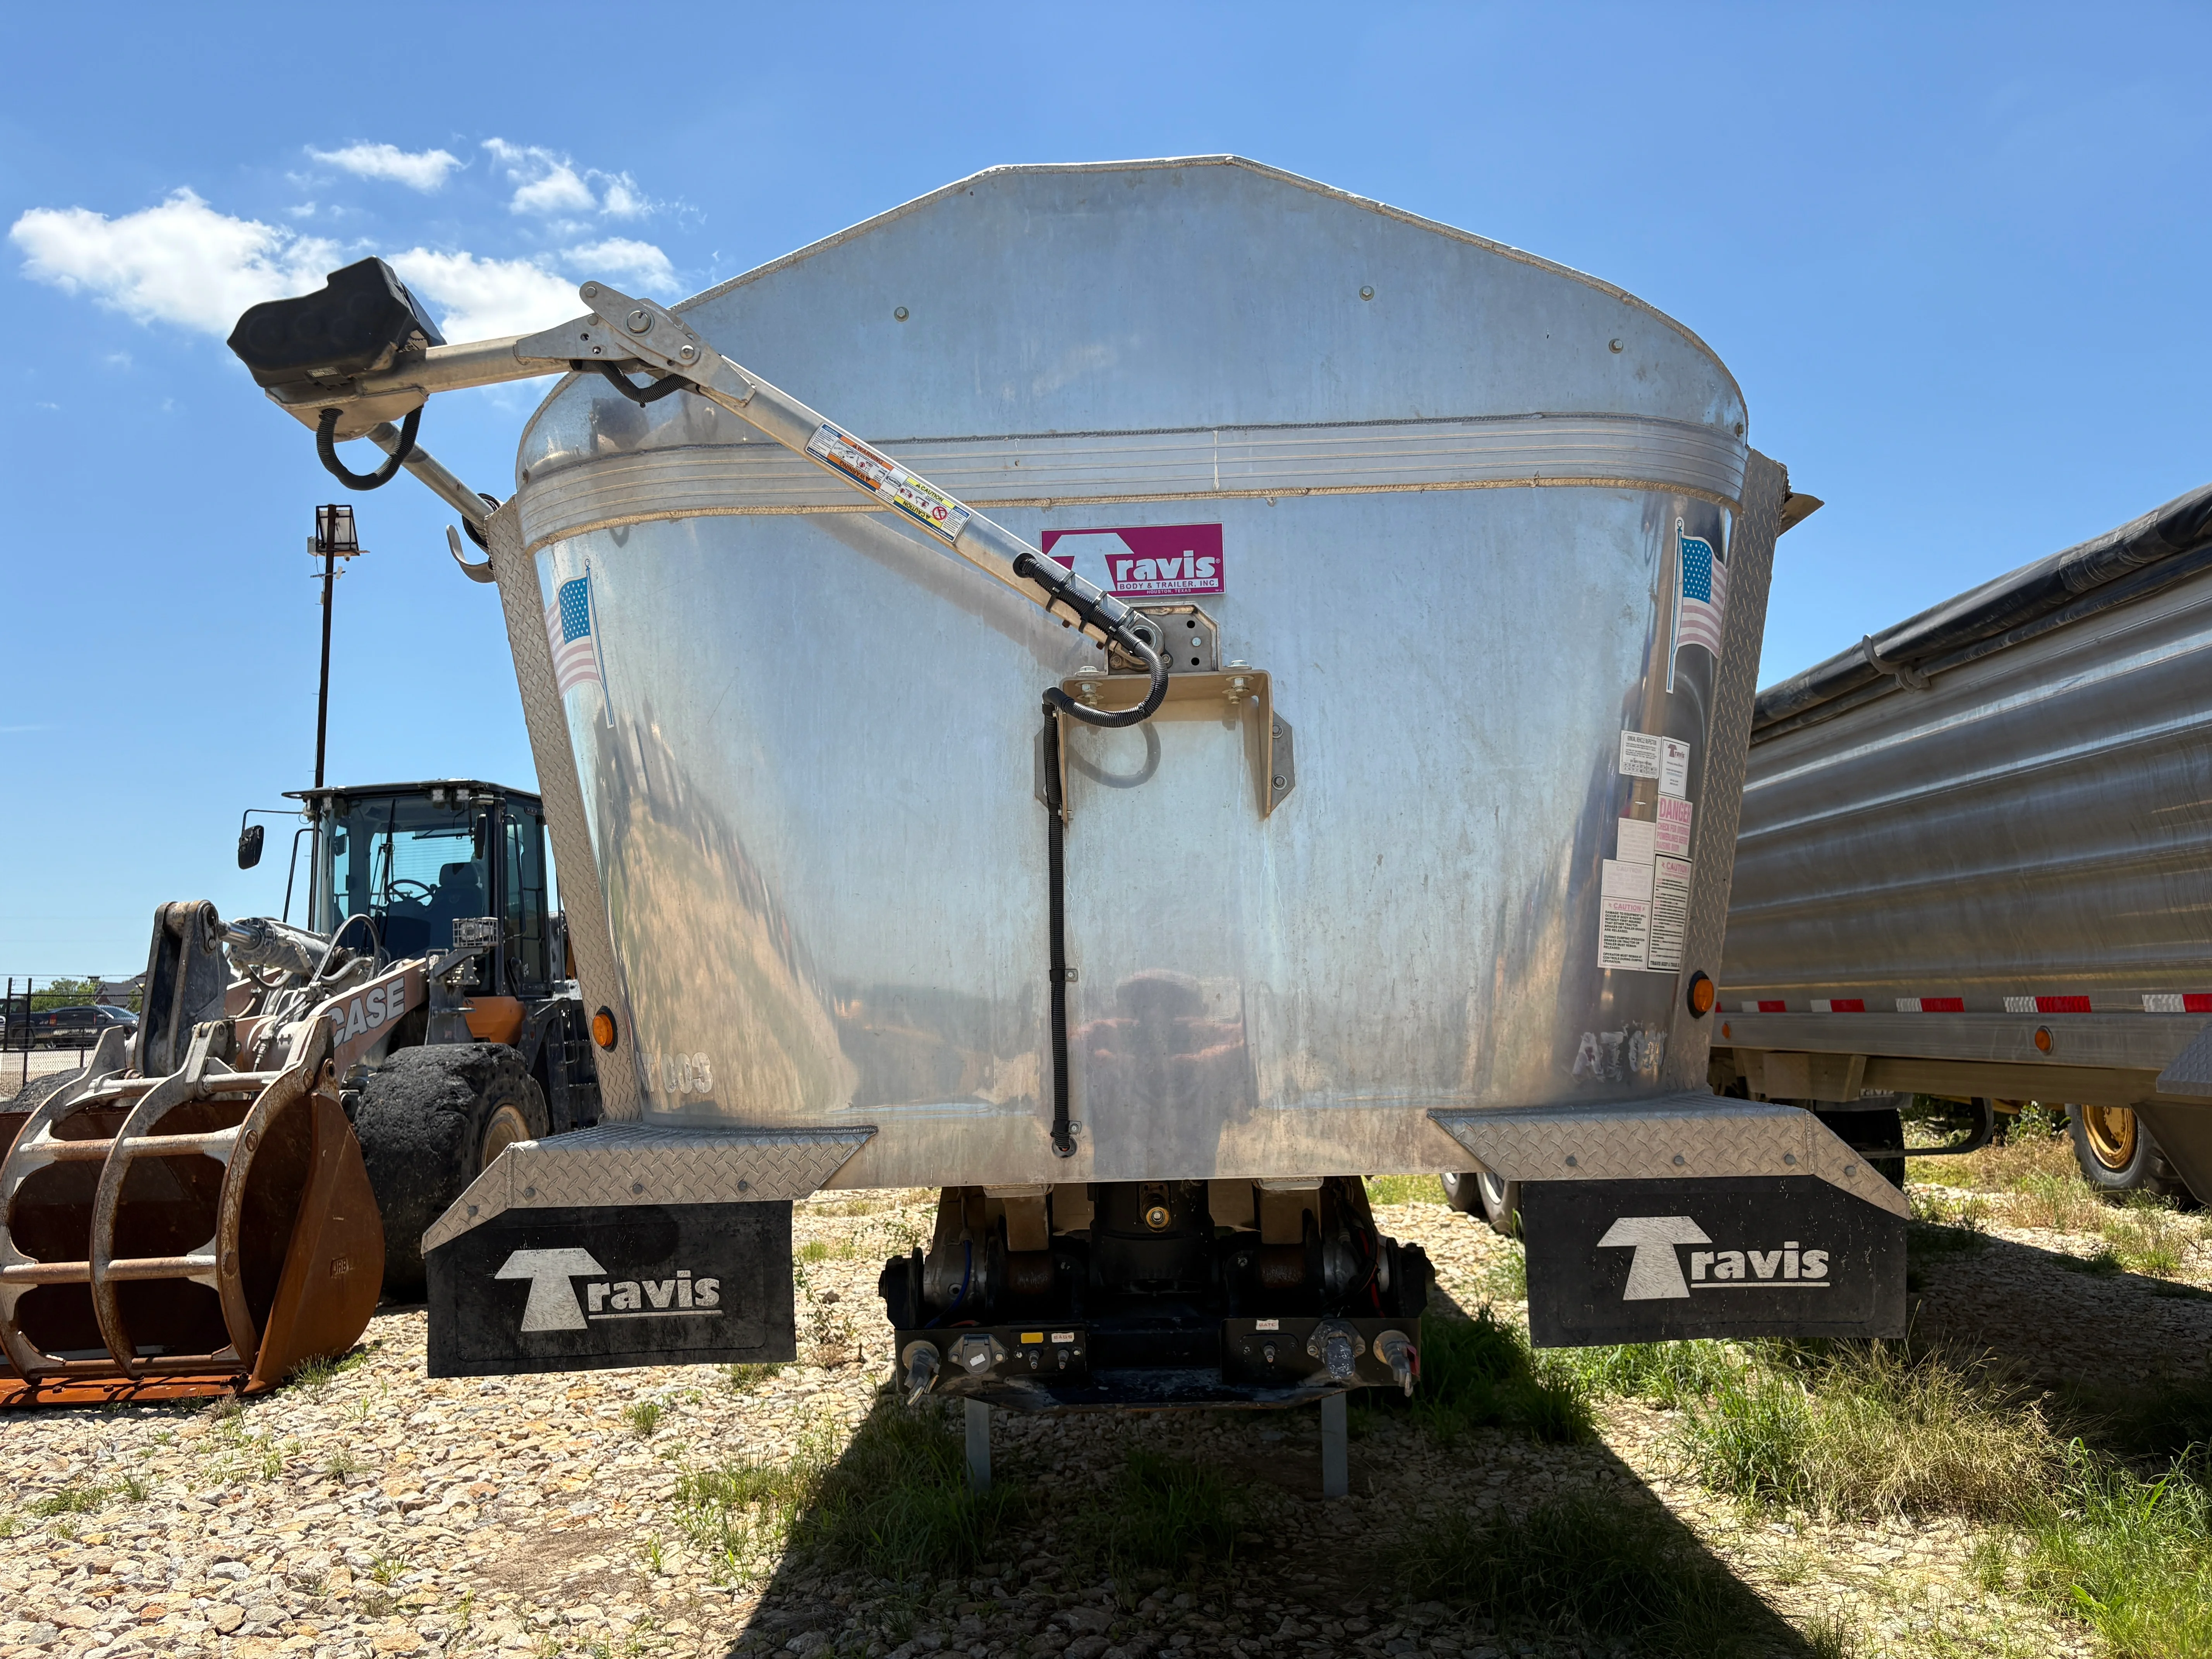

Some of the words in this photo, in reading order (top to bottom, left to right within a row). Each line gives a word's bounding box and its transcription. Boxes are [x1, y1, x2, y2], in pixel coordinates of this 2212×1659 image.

[858, 446, 883, 464] WARNING
[840, 461, 865, 480] WARNING
[921, 486, 943, 501] CAUTION
[903, 501, 925, 517] CAUTION
[1668, 744, 1685, 758] Travis
[1659, 798, 1692, 823] DANGER
[1614, 903, 1641, 911] CAUTION
[326, 976, 405, 1049] CASE
[334, 1260, 347, 1273] JRB
[1597, 1216, 1829, 1300] Travis
[495, 1248, 720, 1332] Travis
